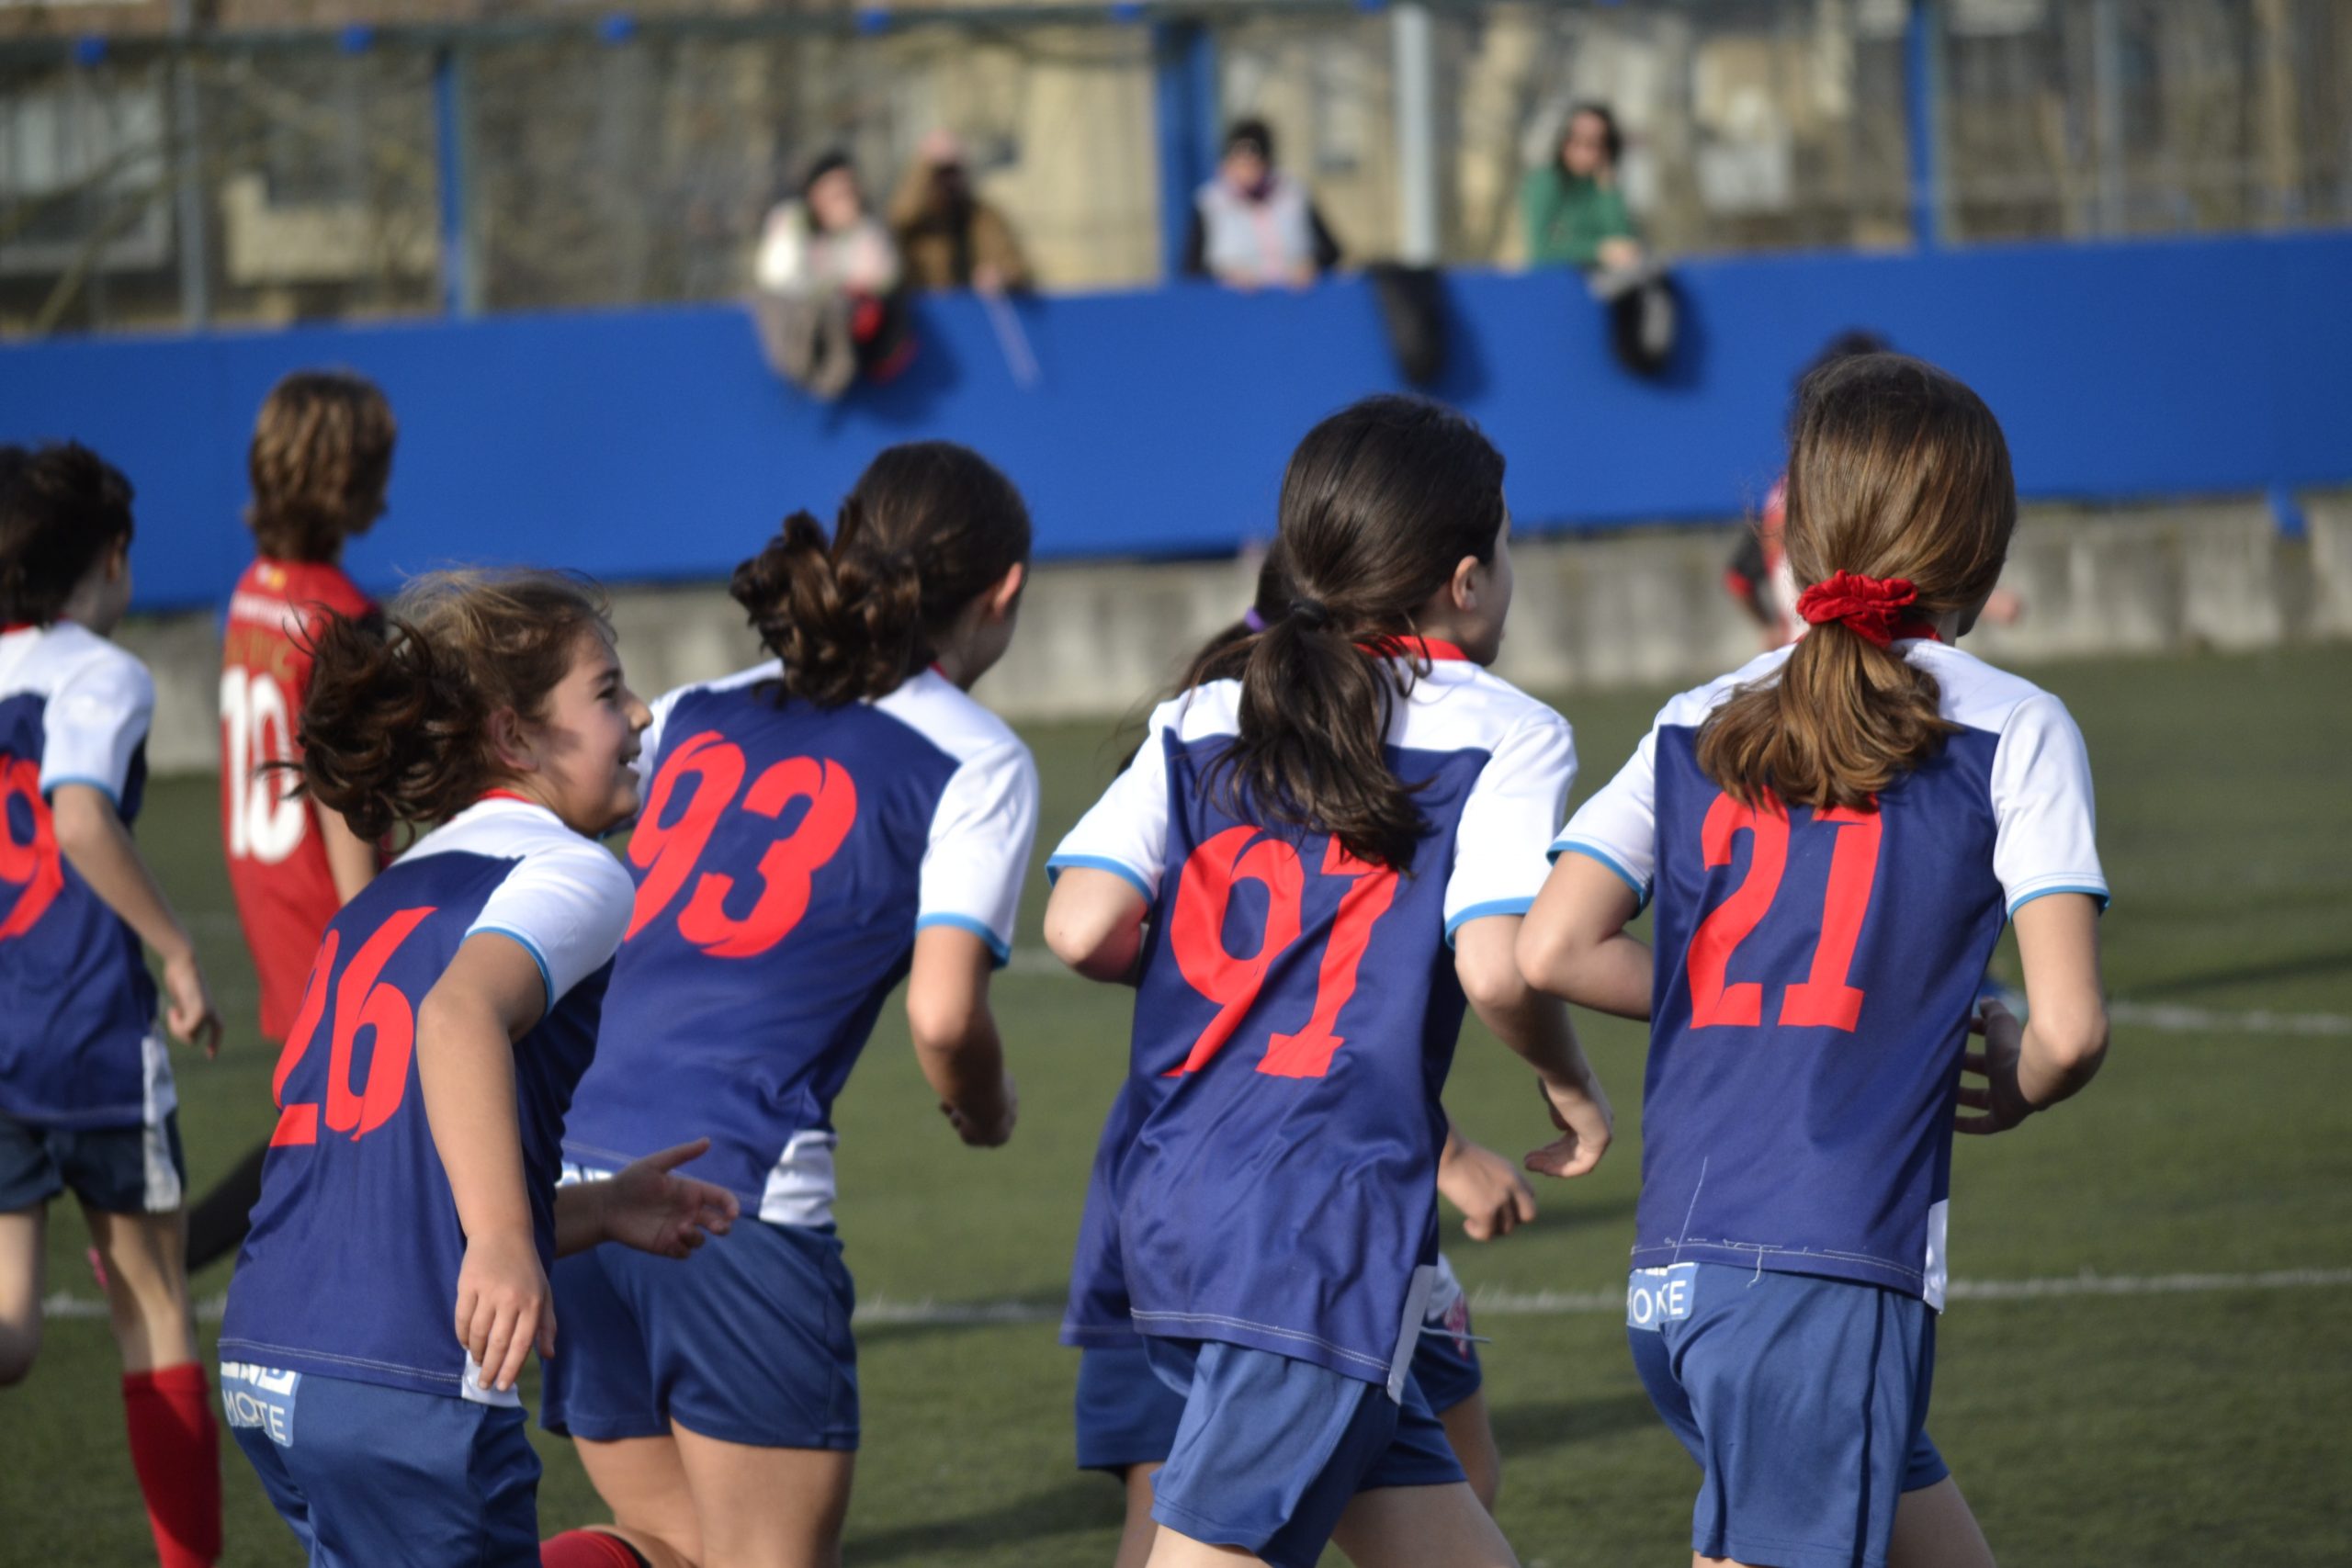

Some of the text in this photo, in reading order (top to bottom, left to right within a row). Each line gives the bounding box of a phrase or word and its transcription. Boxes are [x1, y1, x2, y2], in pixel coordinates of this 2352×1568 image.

[219, 665, 306, 864] 10
[625, 730, 857, 958] 93
[269, 906, 438, 1146] 26
[1161, 825, 1399, 1079] 91
[1687, 784, 1883, 1033] 21
